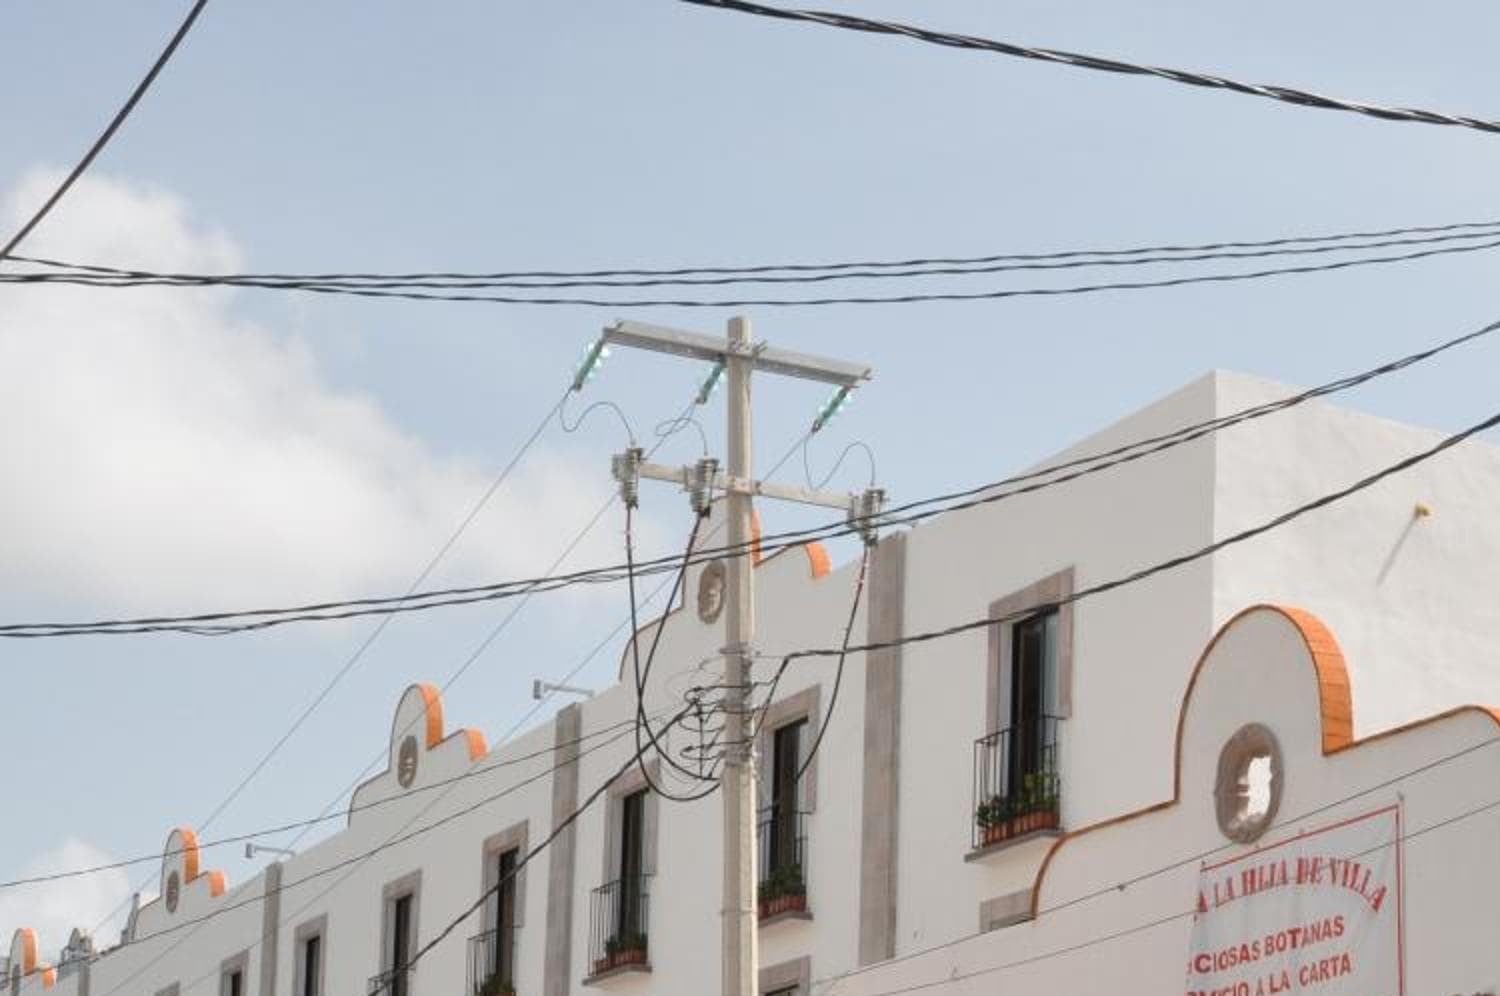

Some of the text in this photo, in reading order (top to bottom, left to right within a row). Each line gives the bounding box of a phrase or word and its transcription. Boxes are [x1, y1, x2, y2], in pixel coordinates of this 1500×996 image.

[1296, 856, 1323, 885] DE
[1329, 857, 1388, 913] VILLA
[1263, 915, 1346, 957] BOTANAS
[1269, 970, 1292, 995] LA
[1299, 953, 1353, 988] CARTA
